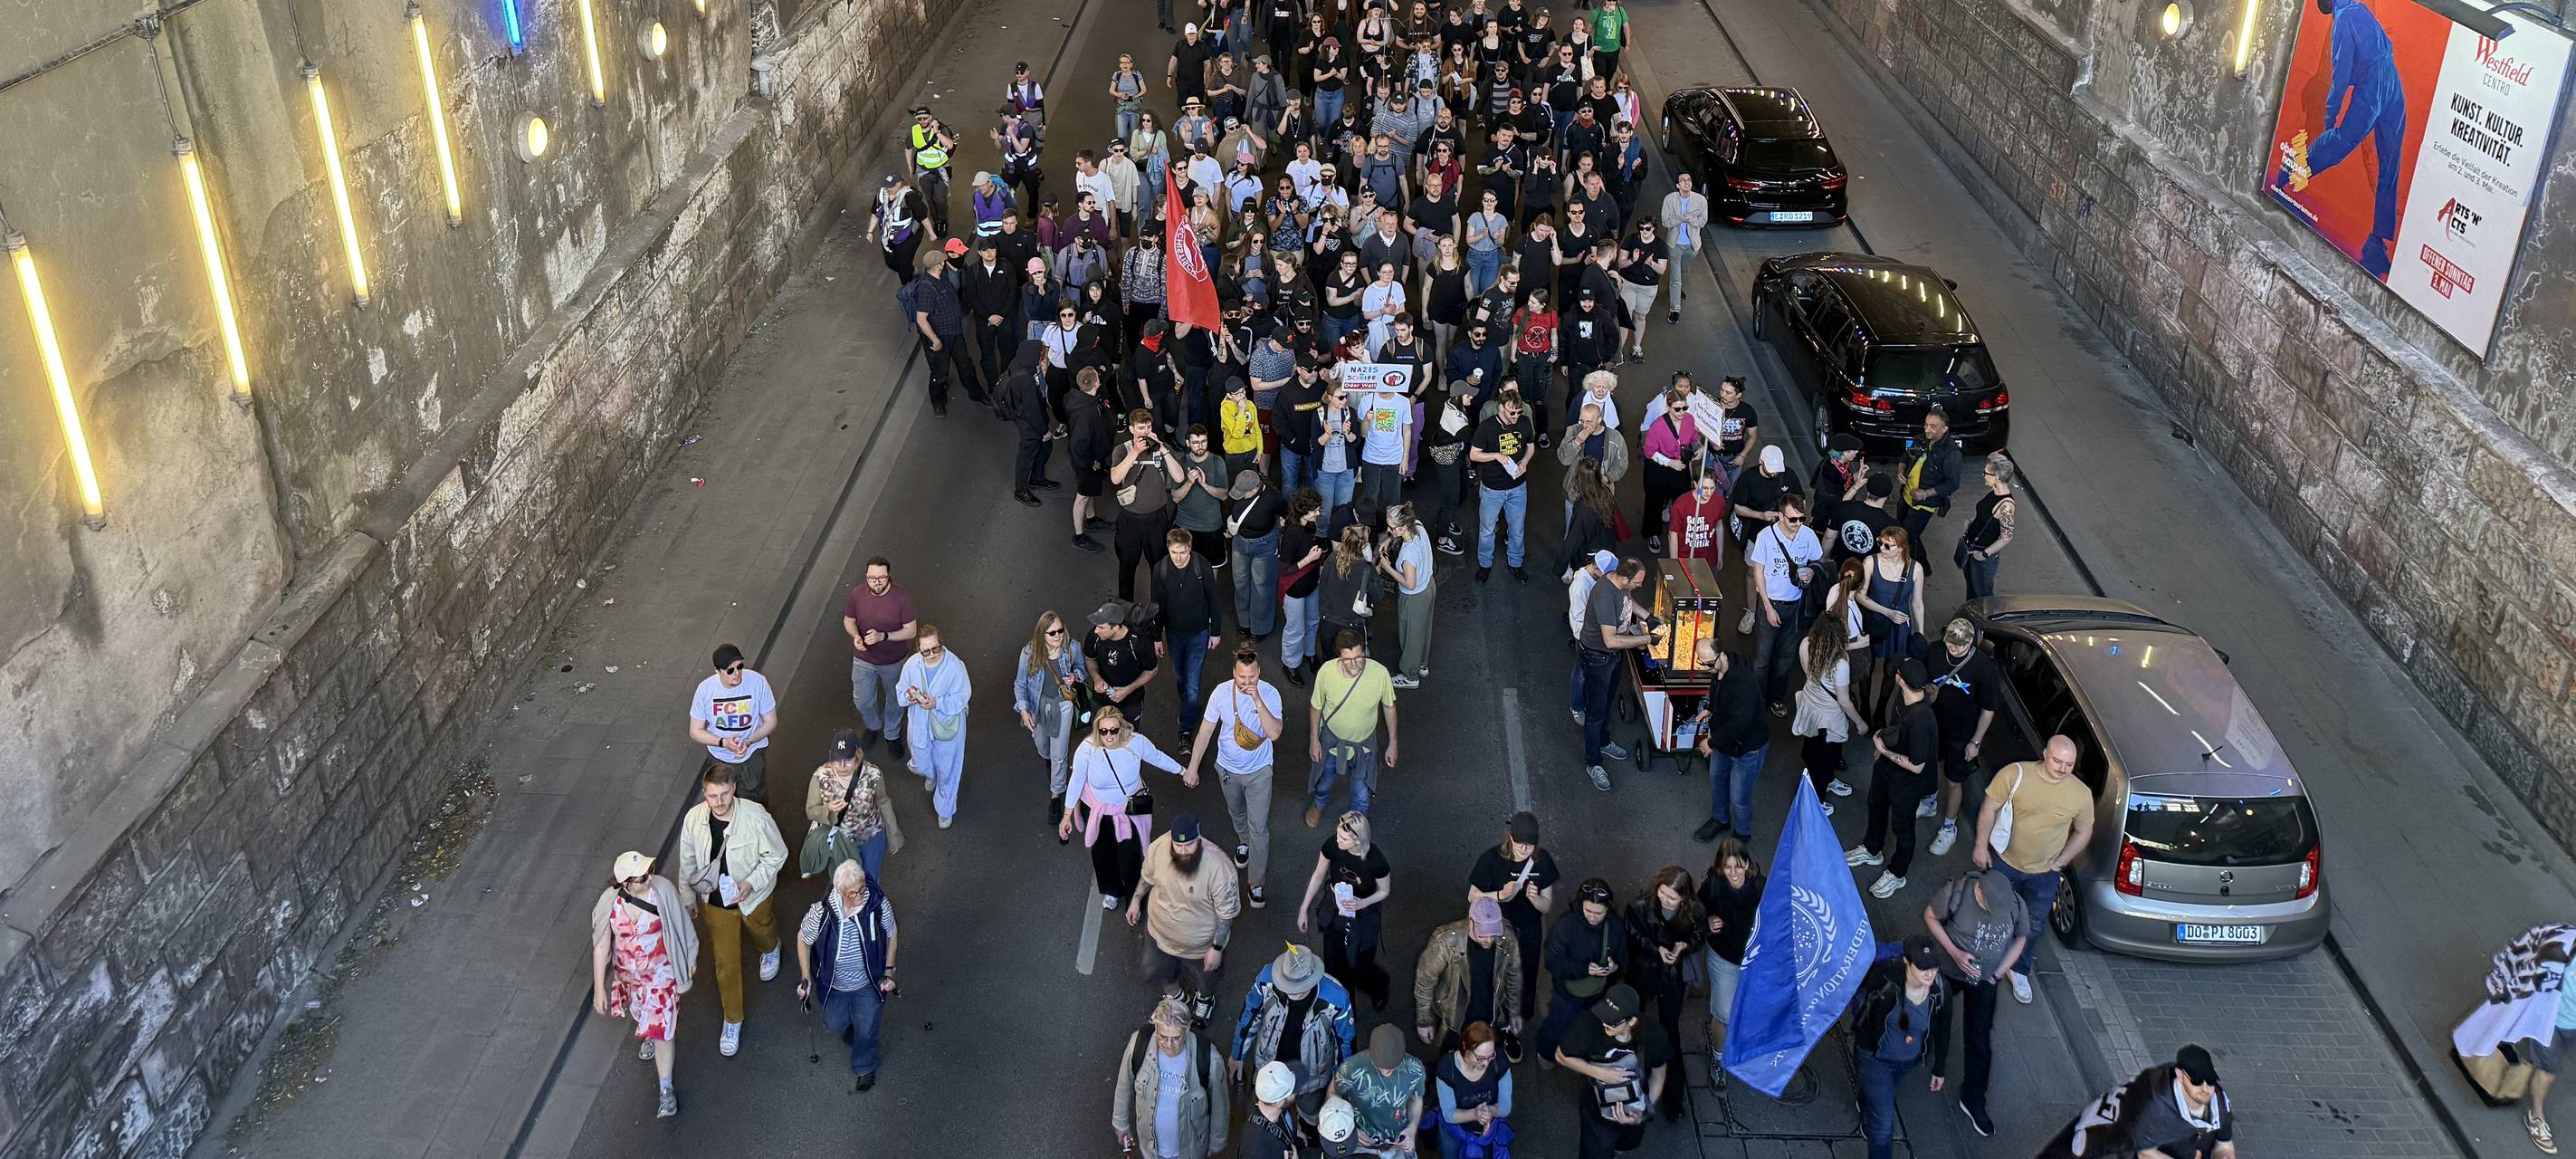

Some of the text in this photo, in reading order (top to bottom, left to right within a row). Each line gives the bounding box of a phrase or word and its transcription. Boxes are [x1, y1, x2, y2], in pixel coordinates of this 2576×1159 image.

[2474, 35, 2534, 87] Westfield
[2483, 73, 2511, 96] CENTRO
[2451, 91, 2523, 148] KUNST. KULTUR.
[2451, 117, 2511, 167] KREATIVITÄT.
[2281, 151, 2307, 178] hausen
[2433, 141, 2518, 197] Erlebe die Vielfalt der Kreation
[2447, 161, 2457, 172] am
[2464, 170, 2476, 182] und
[2422, 246, 2473, 291] OFFENER SONNTAG
[2433, 273, 2452, 298] 3. MAI
[712, 701, 751, 716] FCK
[715, 714, 753, 727] AFD
[2187, 925, 2257, 939] DO PI 8003
